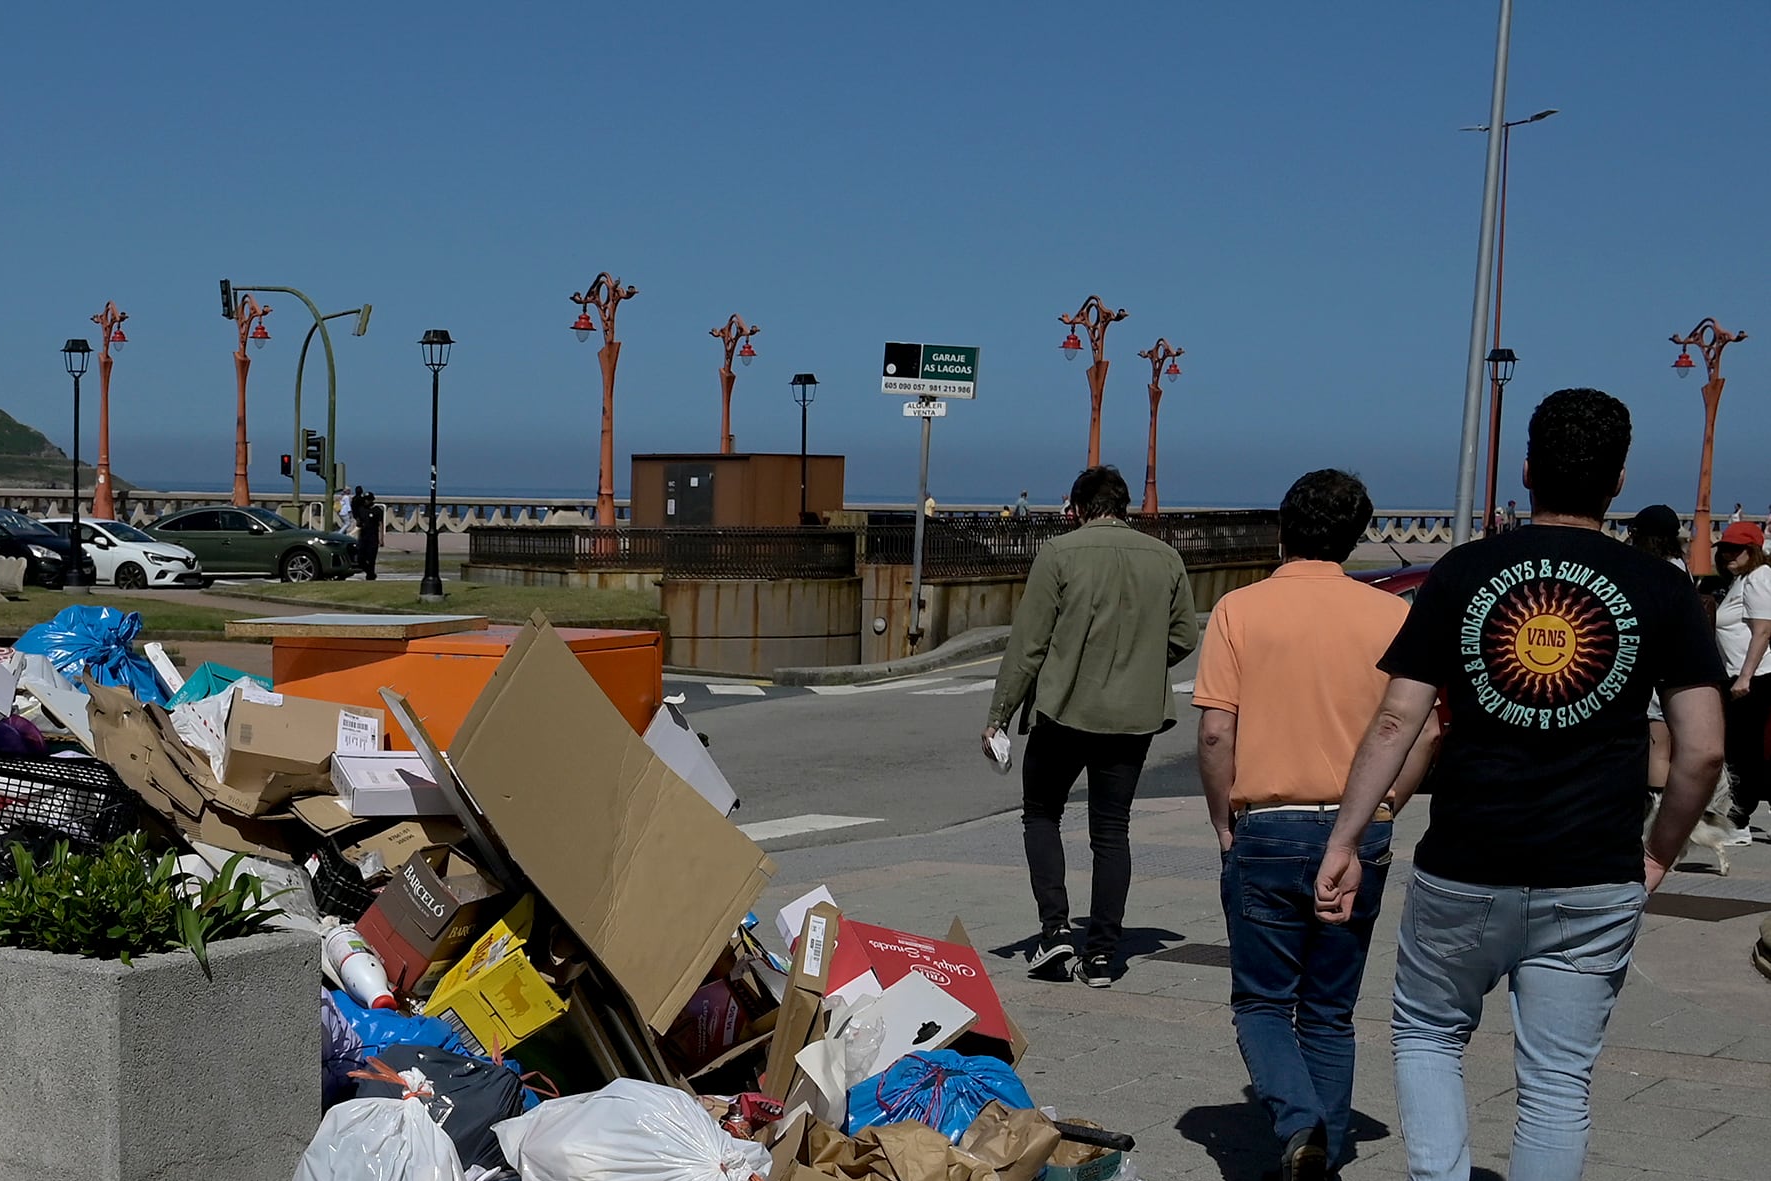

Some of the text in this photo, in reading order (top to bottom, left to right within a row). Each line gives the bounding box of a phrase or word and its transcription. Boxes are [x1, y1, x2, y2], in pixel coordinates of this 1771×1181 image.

[932, 353, 966, 363] GARAJE
[924, 364, 973, 374] AS LAGOAS
[929, 384, 941, 392] 981
[944, 385, 956, 393] 213
[1461, 559, 1640, 729] ENDLESS DAYS & SUN RAYS & ENDLESS DAYS & SUN RAYS &
[1527, 628, 1567, 648] VANS
[403, 864, 445, 919] BARCELÓ
[869, 939, 921, 958] Snacks
[932, 961, 976, 977] Chips
